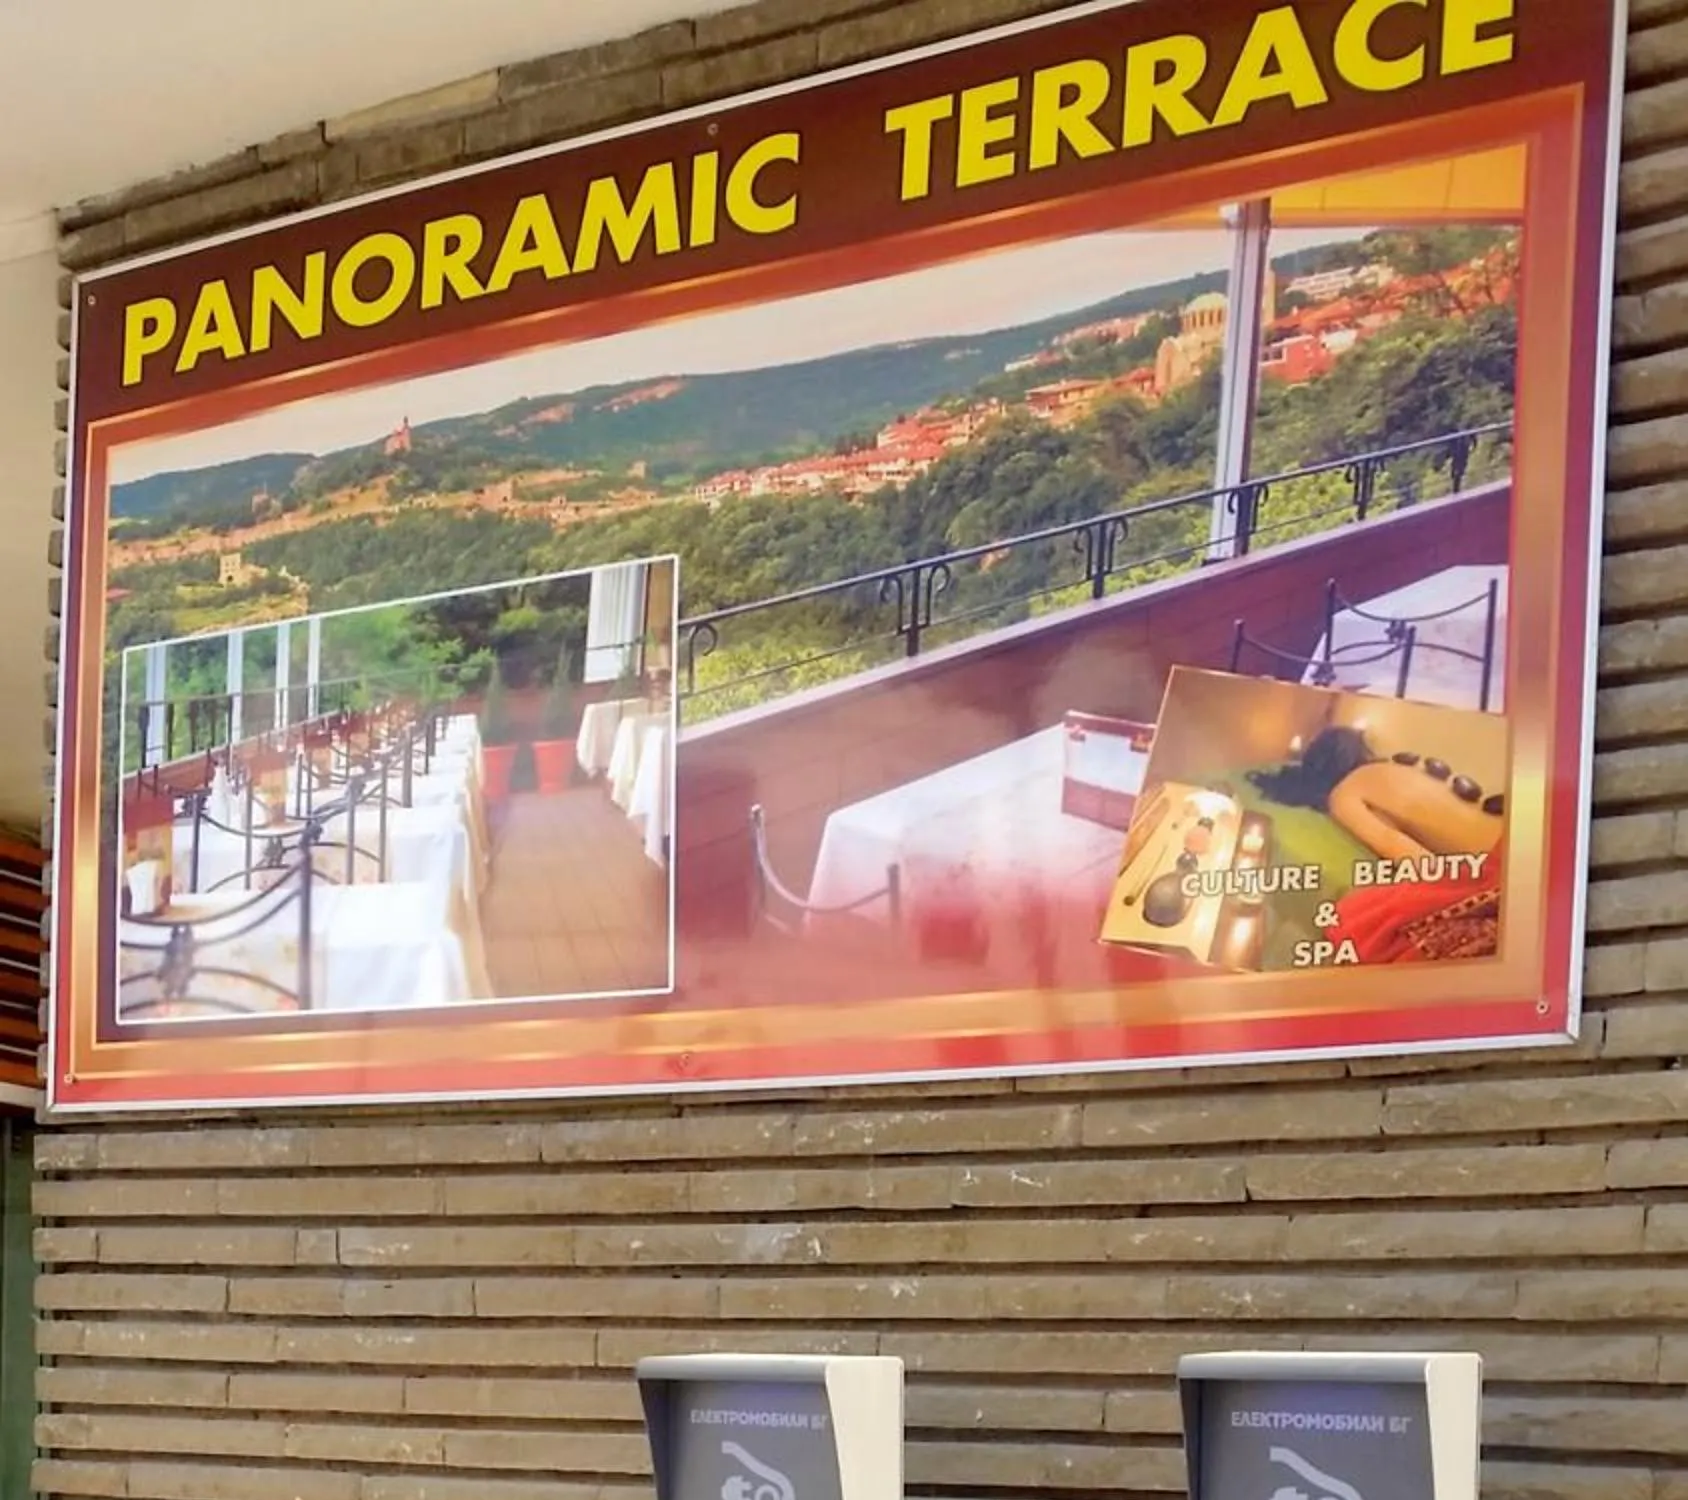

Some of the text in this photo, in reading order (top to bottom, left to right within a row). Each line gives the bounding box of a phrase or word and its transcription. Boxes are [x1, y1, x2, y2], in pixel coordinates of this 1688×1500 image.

[122, 0, 1515, 387] PANORAMIC TERRACE
[1180, 853, 1487, 899] CULTURE BEAUTY
[1314, 903, 1340, 928] &
[1293, 940, 1359, 966] SPA
[1231, 1411, 1411, 1433] ЕЛЕКТРОМОБИЛИ БГ
